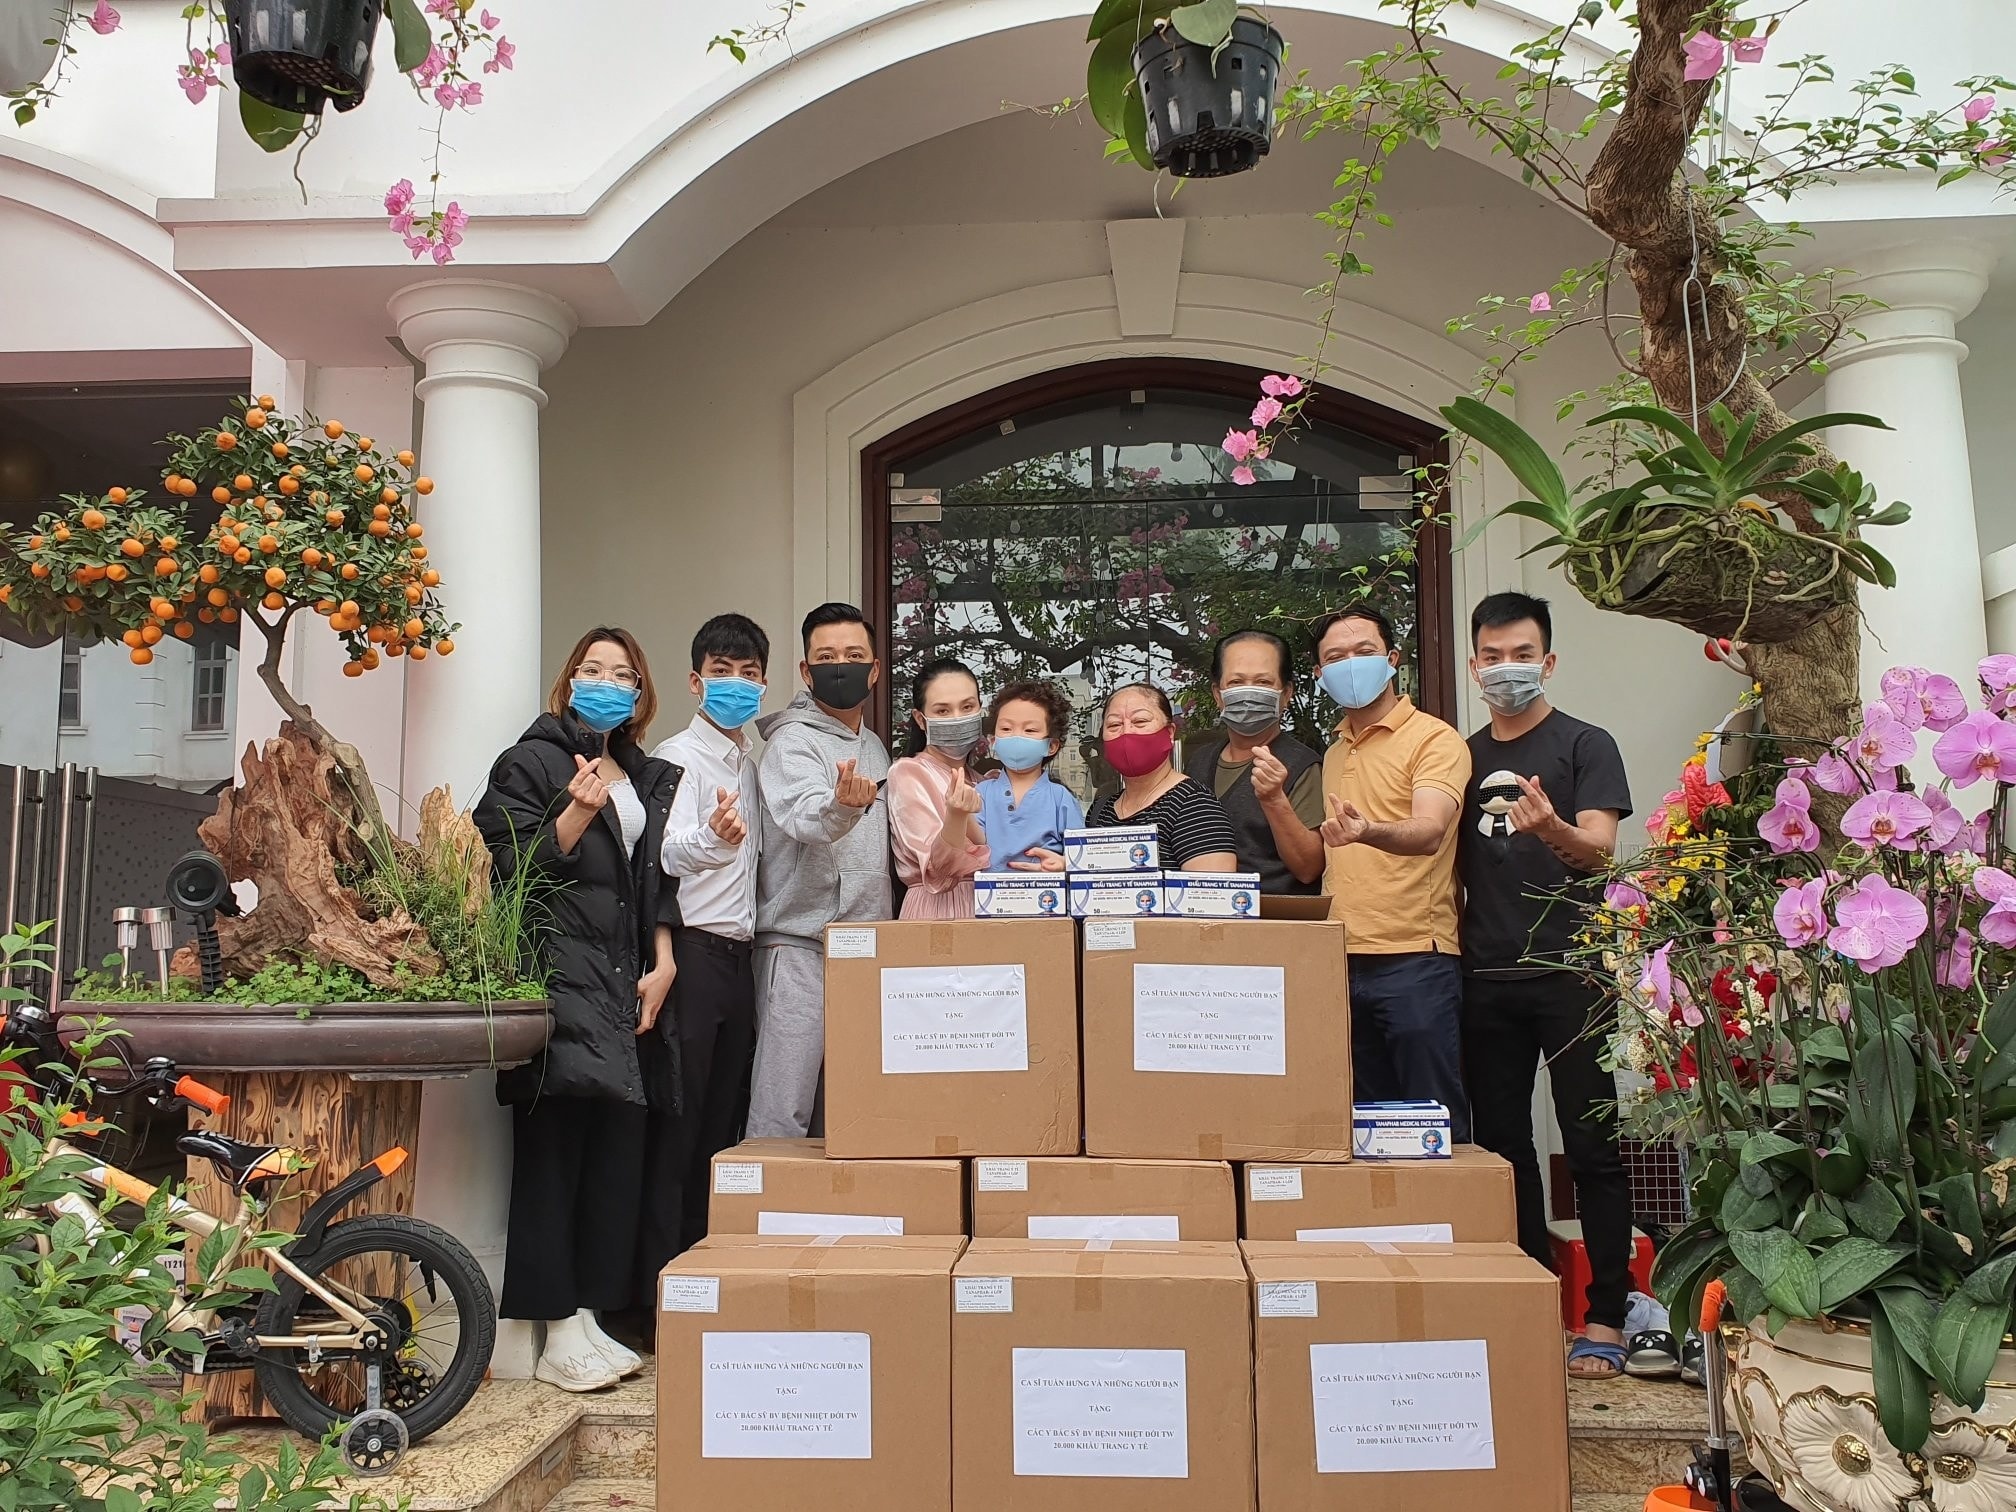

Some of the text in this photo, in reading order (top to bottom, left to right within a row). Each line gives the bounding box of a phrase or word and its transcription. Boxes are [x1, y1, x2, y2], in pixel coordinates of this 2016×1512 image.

[1391, 1398, 1413, 1406] TẶNG
[782, 1412, 802, 1420] BỆNH
[804, 1412, 828, 1420] NHIỆT
[1399, 1423, 1420, 1432] BỆNH
[1422, 1422, 1447, 1431] NHIỆT
[1095, 1430, 1116, 1438] BỆNH
[1119, 1430, 1143, 1438] NHIỆT
